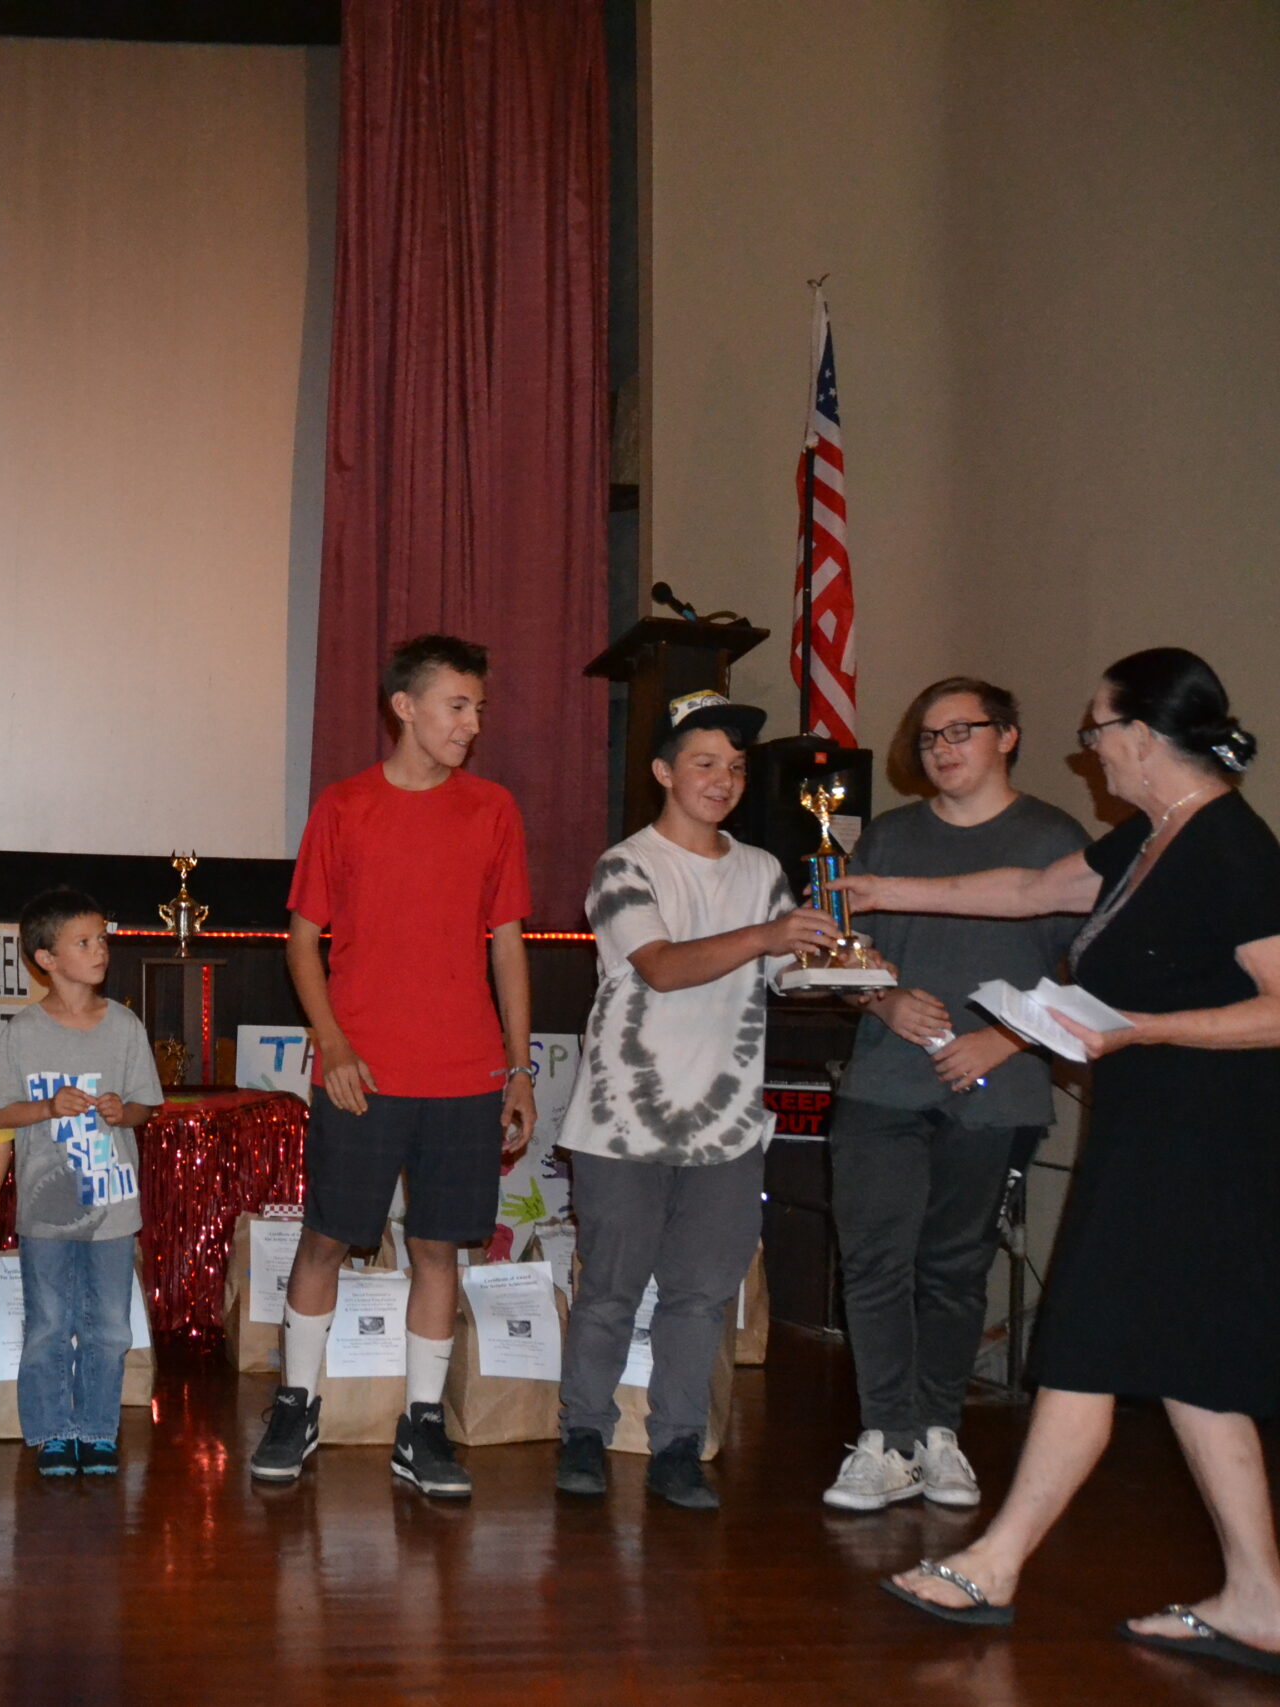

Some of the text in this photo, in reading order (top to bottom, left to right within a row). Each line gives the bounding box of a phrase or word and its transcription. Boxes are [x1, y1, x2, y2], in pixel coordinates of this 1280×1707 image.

[762, 1091, 831, 1112] KEEP
[51, 1103, 98, 1142] ME
[66, 1132, 119, 1178] SEA
[77, 1163, 139, 1207] FOOD
